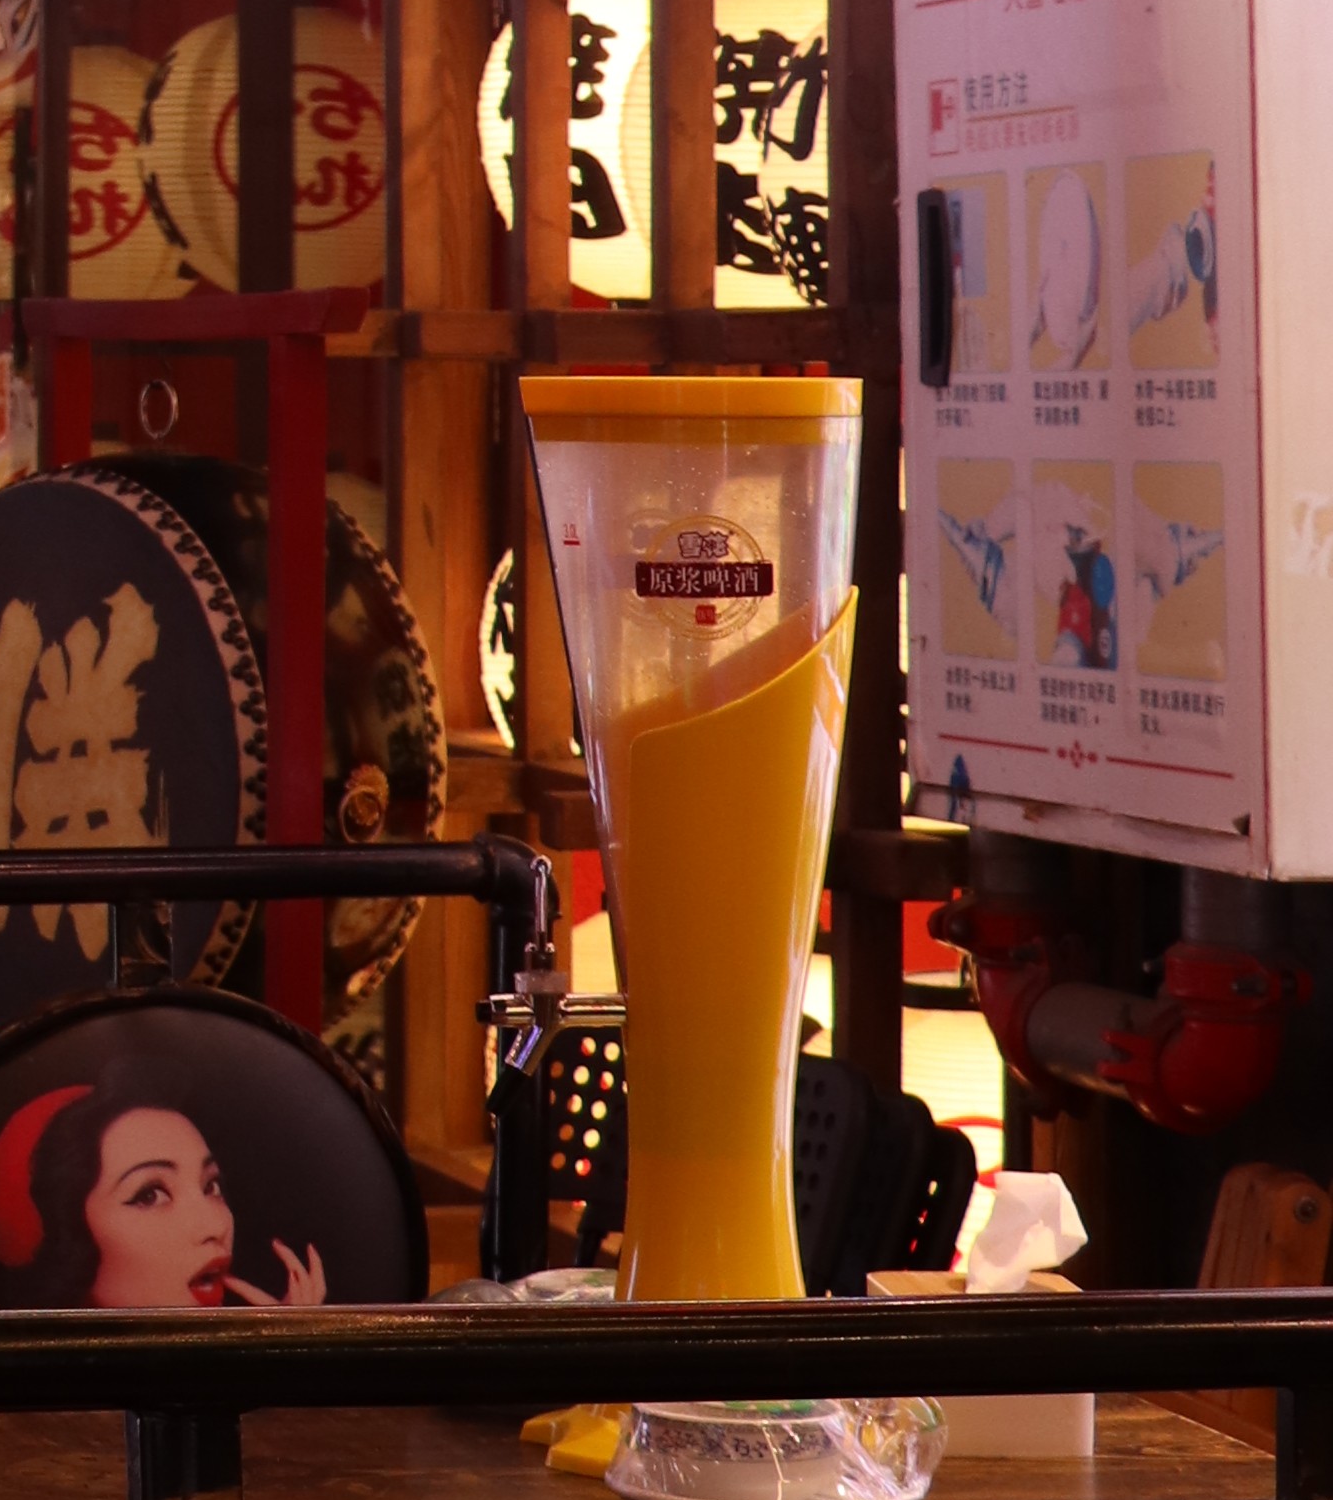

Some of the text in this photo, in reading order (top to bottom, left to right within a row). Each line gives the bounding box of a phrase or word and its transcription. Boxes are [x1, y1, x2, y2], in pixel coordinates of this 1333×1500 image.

[964, 71, 1028, 113] 使用方法
[677, 530, 730, 559] 雪花
[649, 564, 759, 595] 原浆啤酒
